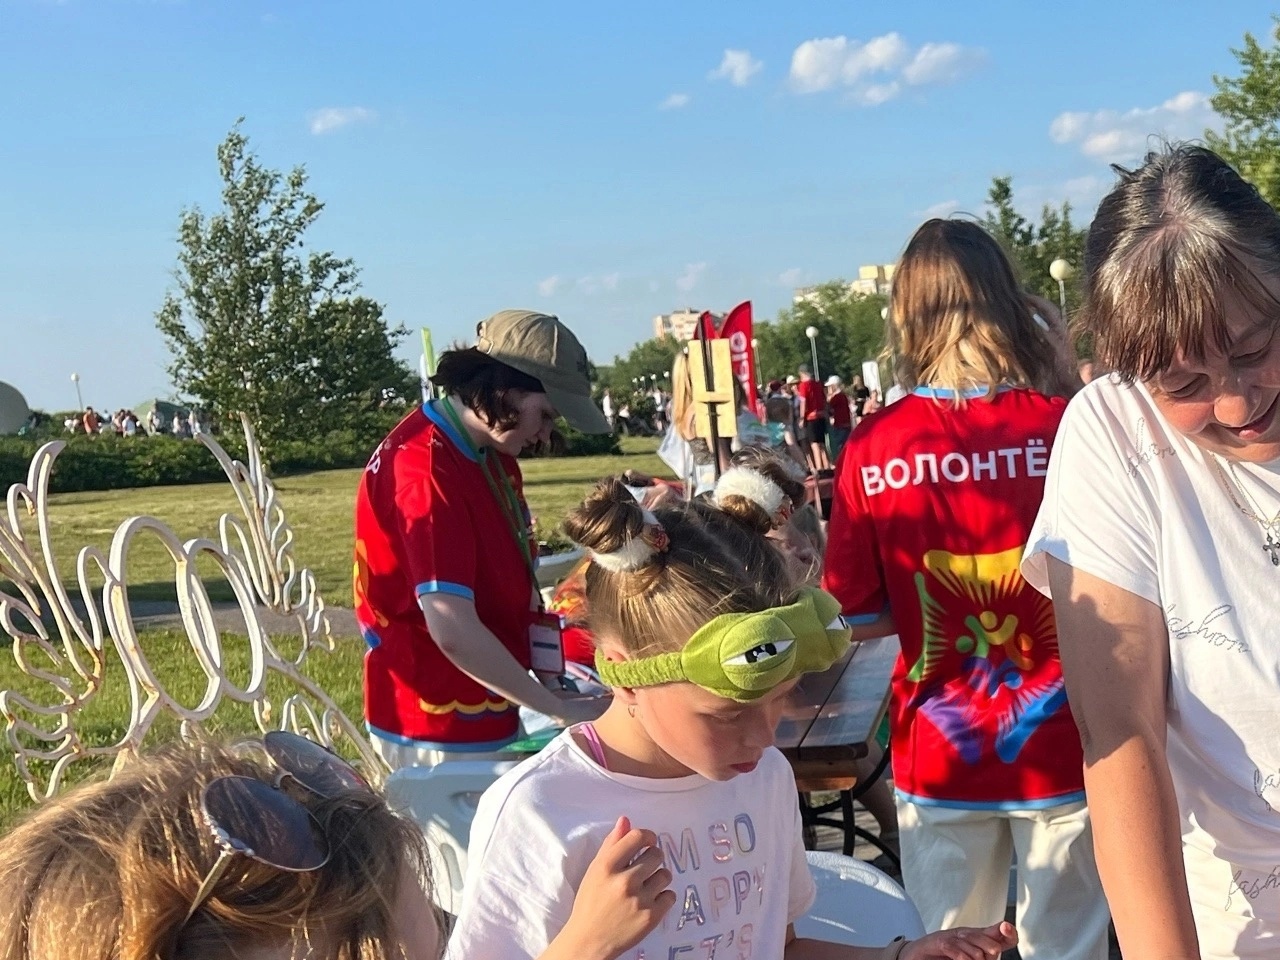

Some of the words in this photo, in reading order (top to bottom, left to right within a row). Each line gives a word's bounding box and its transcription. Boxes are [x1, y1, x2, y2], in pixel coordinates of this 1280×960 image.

[861, 439, 1048, 497] ВОЛОНТЁ
[1165, 603, 1250, 654] ashion
[707, 812, 757, 864] SO
[662, 863, 767, 934] APPY
